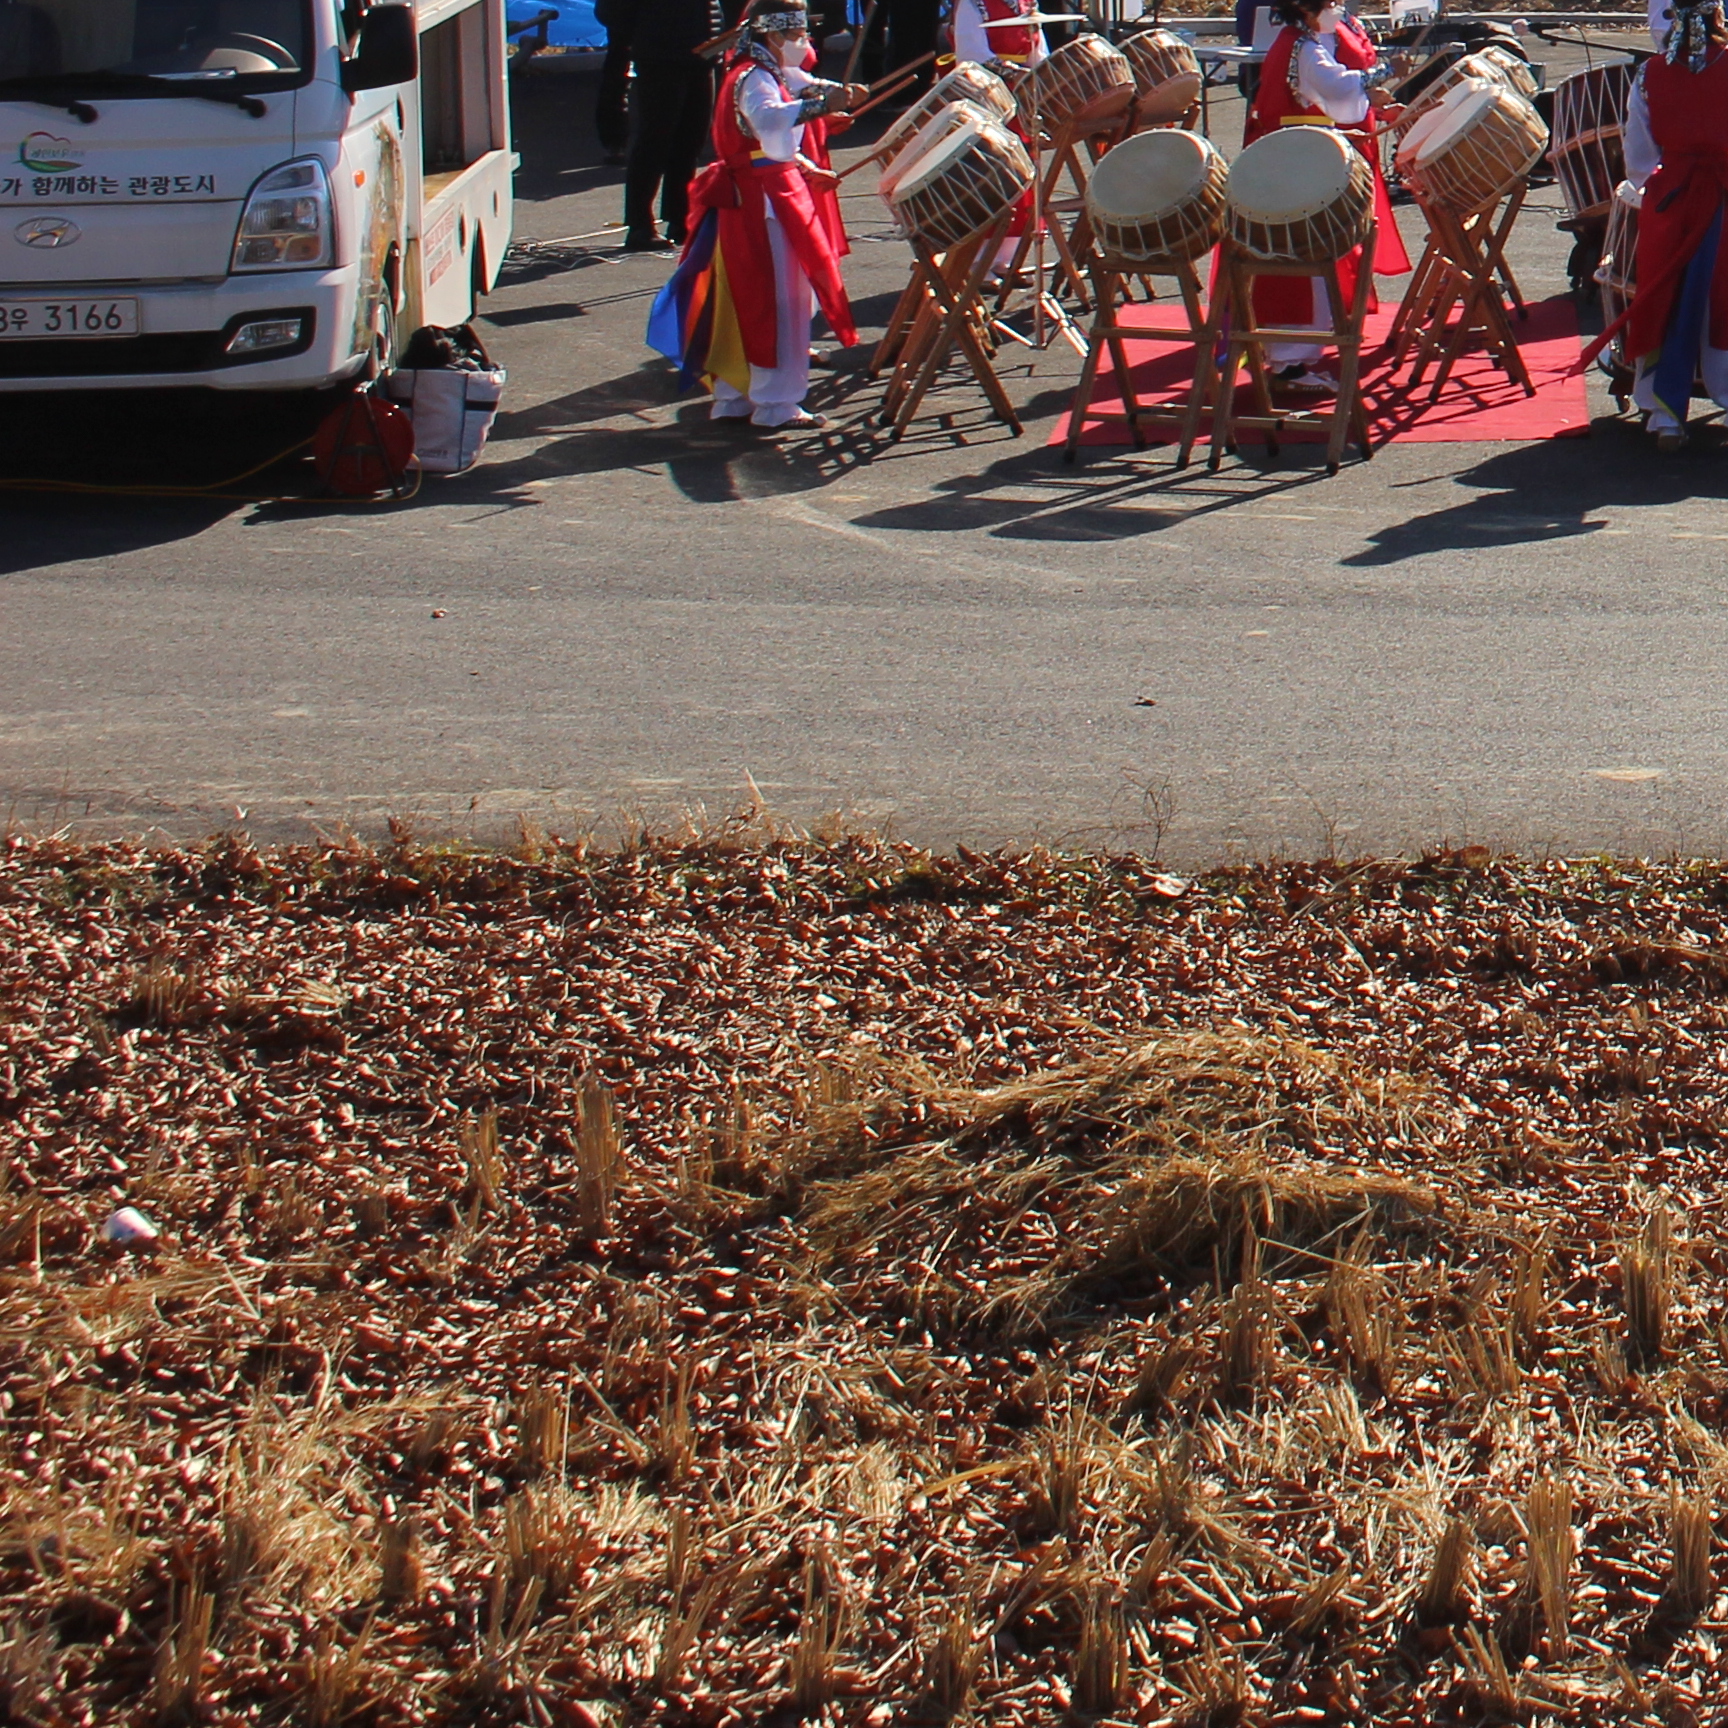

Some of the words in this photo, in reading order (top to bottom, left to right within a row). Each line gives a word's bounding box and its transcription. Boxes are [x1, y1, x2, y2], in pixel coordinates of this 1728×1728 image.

[0, 177, 23, 197] 가
[32, 175, 120, 196] 함께하는
[128, 174, 216, 196] 관광도시
[44, 303, 123, 332] 3166
